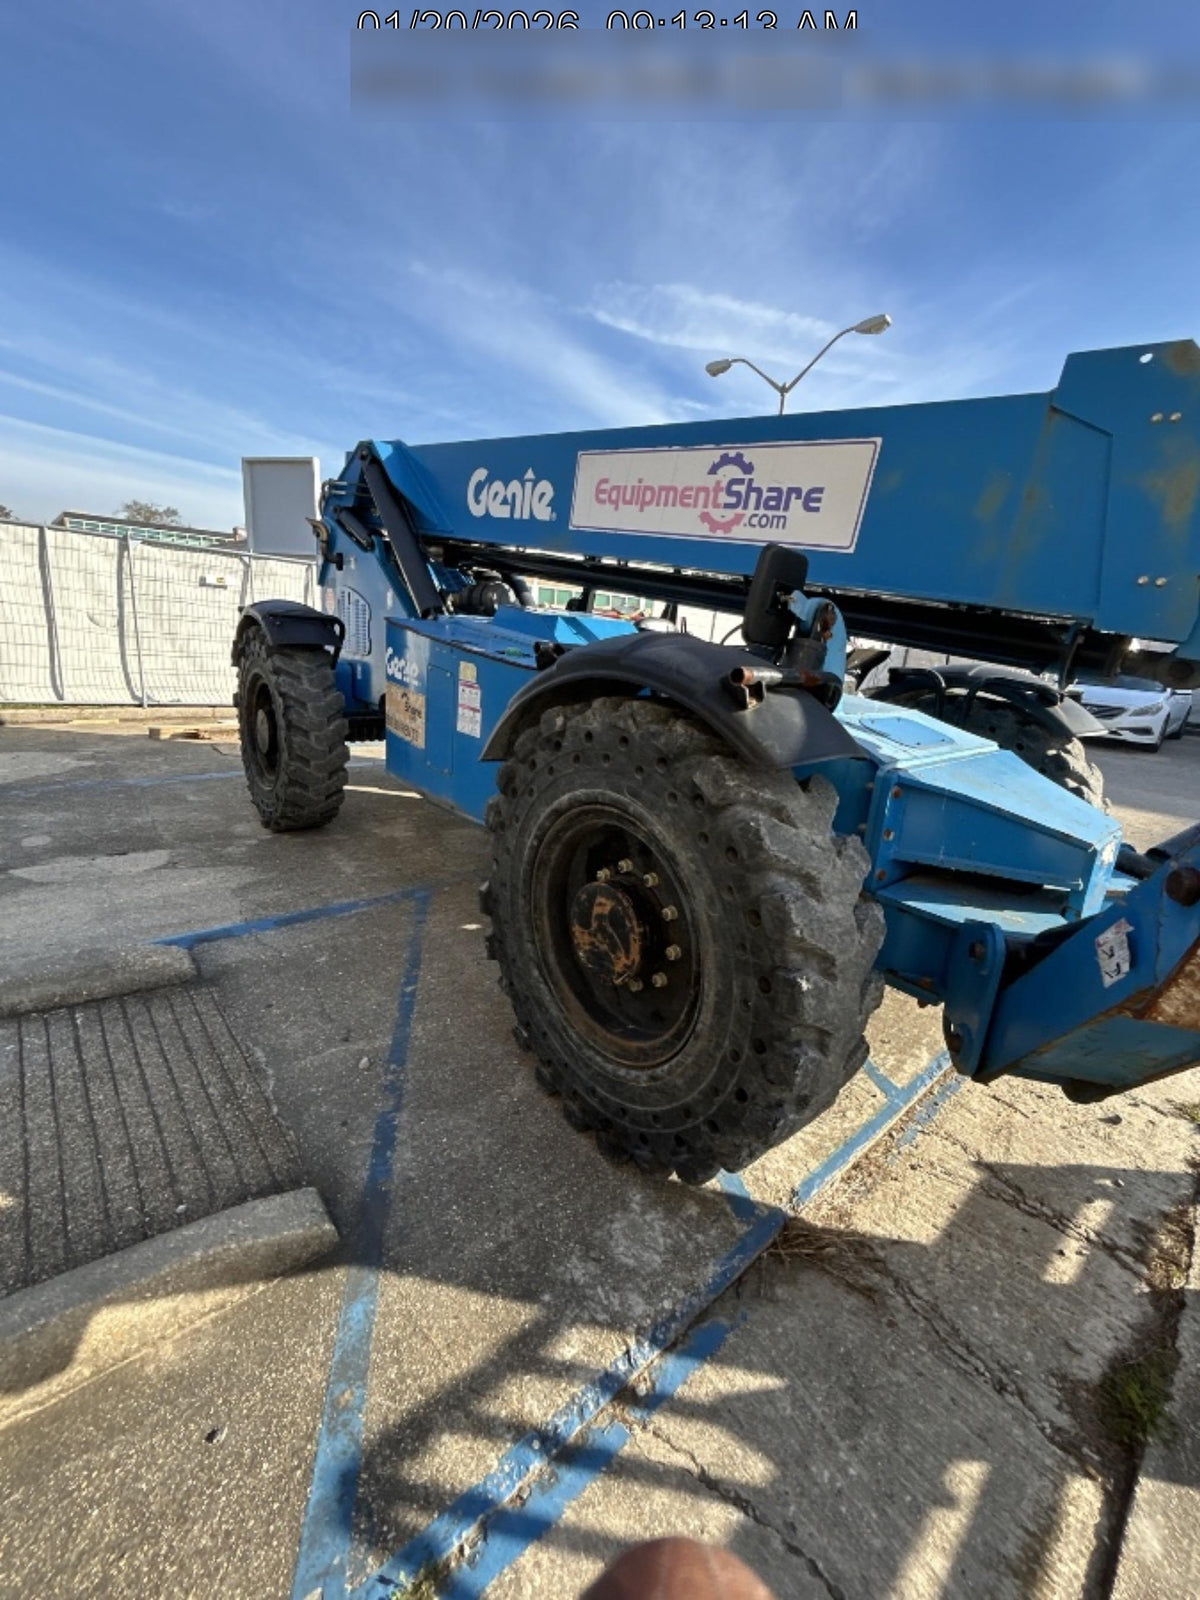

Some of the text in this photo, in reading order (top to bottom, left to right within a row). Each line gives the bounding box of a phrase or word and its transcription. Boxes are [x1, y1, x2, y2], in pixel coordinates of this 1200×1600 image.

[467, 467, 554, 521] Genie
[595, 477, 824, 513] EquipmentShare
[743, 513, 787, 530] .com
